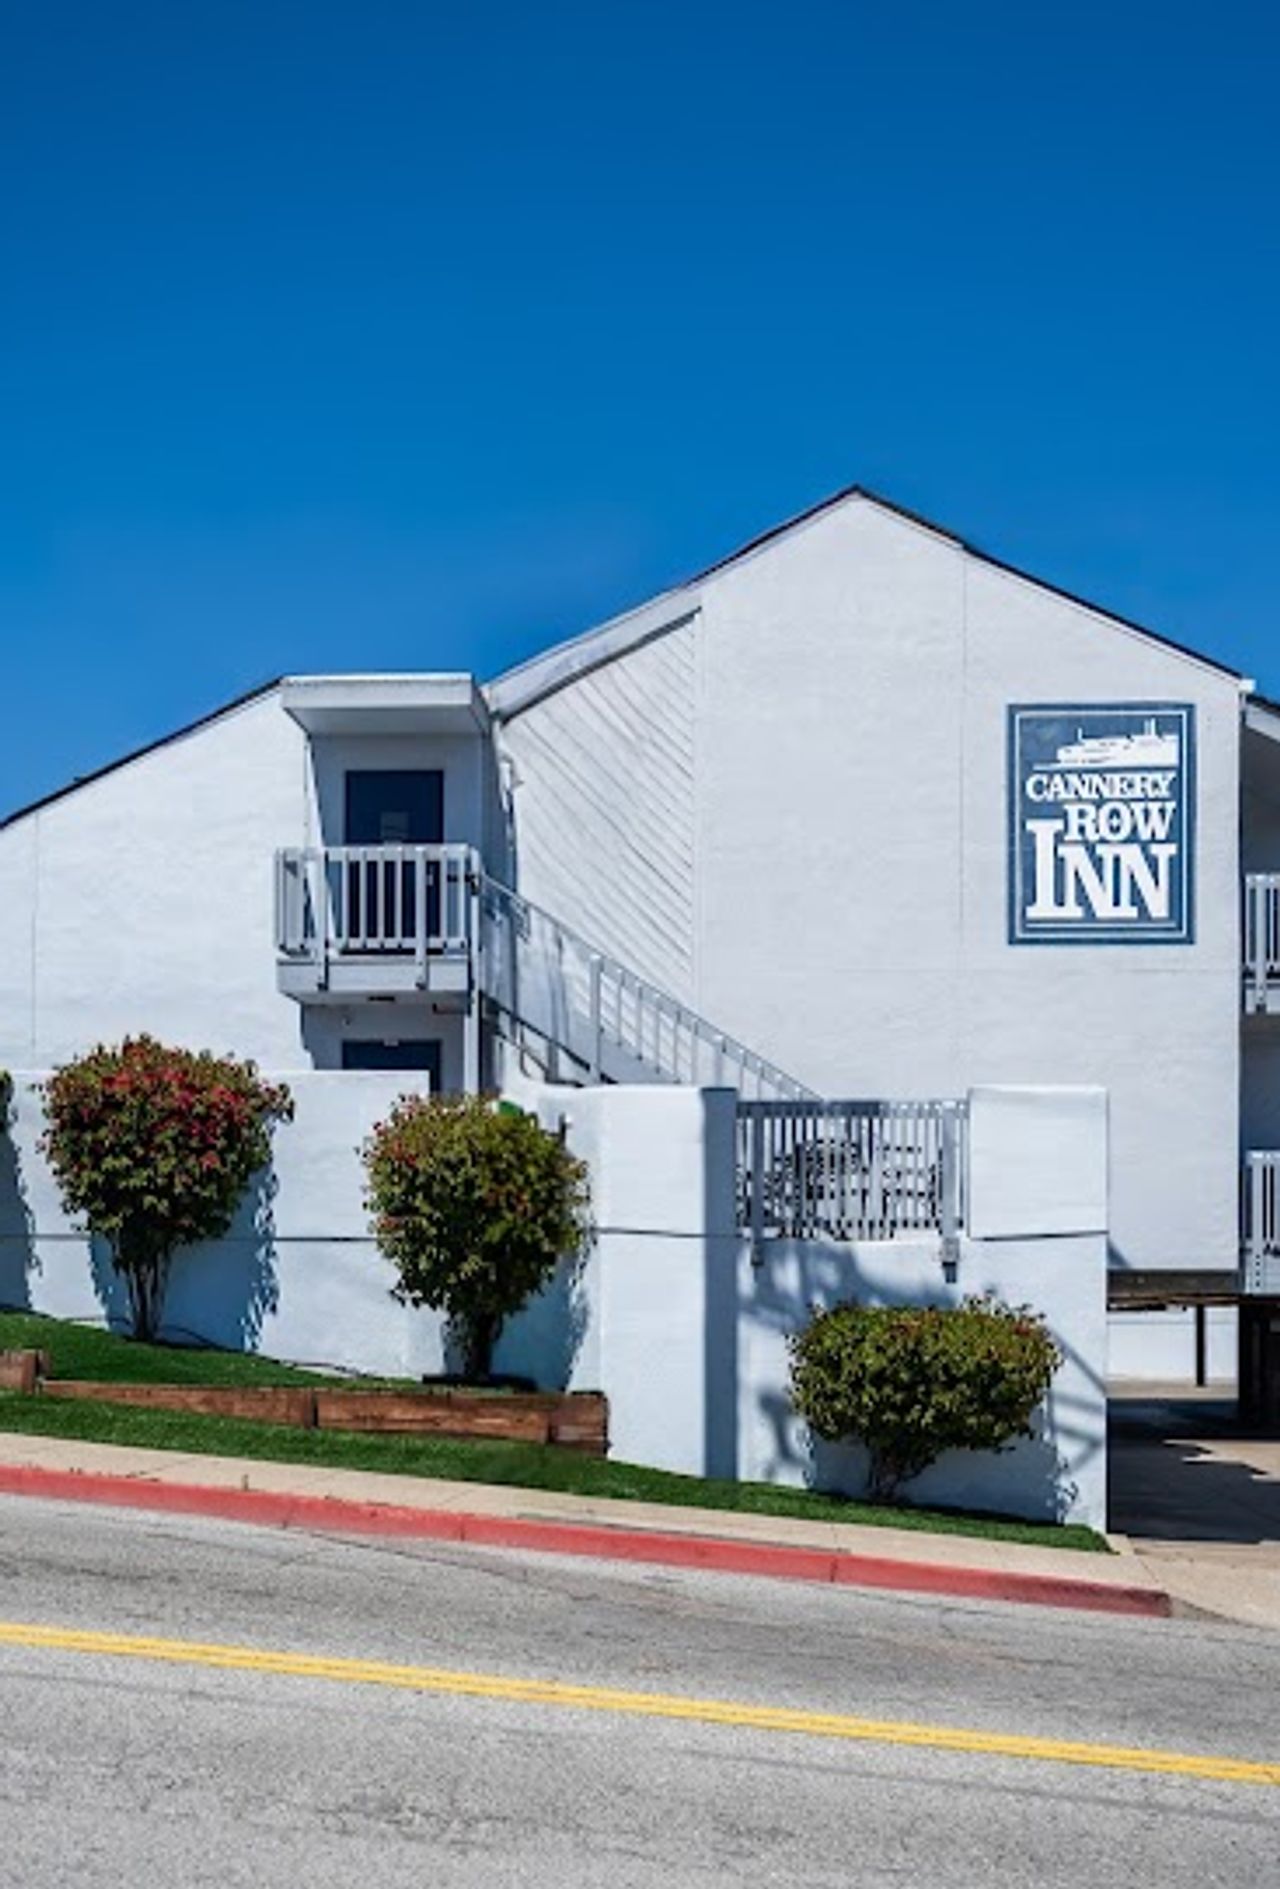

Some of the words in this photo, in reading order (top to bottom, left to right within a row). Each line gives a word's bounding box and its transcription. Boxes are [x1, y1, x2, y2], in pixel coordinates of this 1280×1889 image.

[1025, 772, 1177, 801] CANNERY
[1063, 801, 1177, 842] ROW
[1025, 819, 1177, 919] INN
